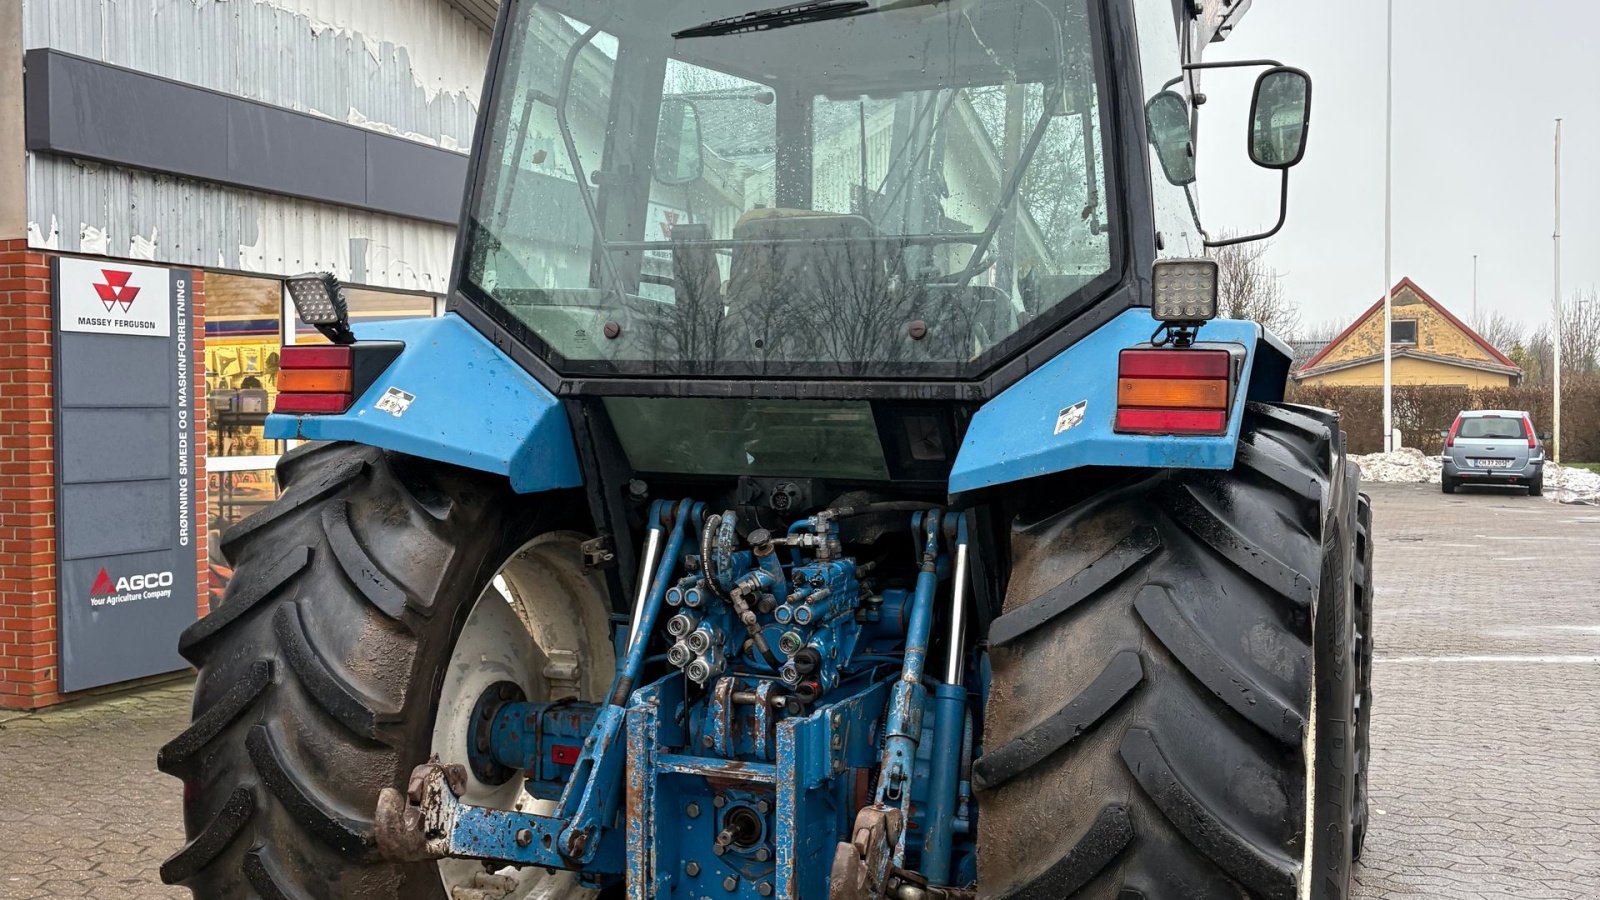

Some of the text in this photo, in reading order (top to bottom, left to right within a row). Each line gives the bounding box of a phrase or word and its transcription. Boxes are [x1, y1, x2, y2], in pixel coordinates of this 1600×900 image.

[78, 317, 156, 329] MASSEY FERGUSON
[177, 279, 188, 546] GRØNNING SMEDE OG MASKINFORRETNING
[115, 571, 173, 593] AGCO
[90, 589, 172, 606] Your Agriculture Company
